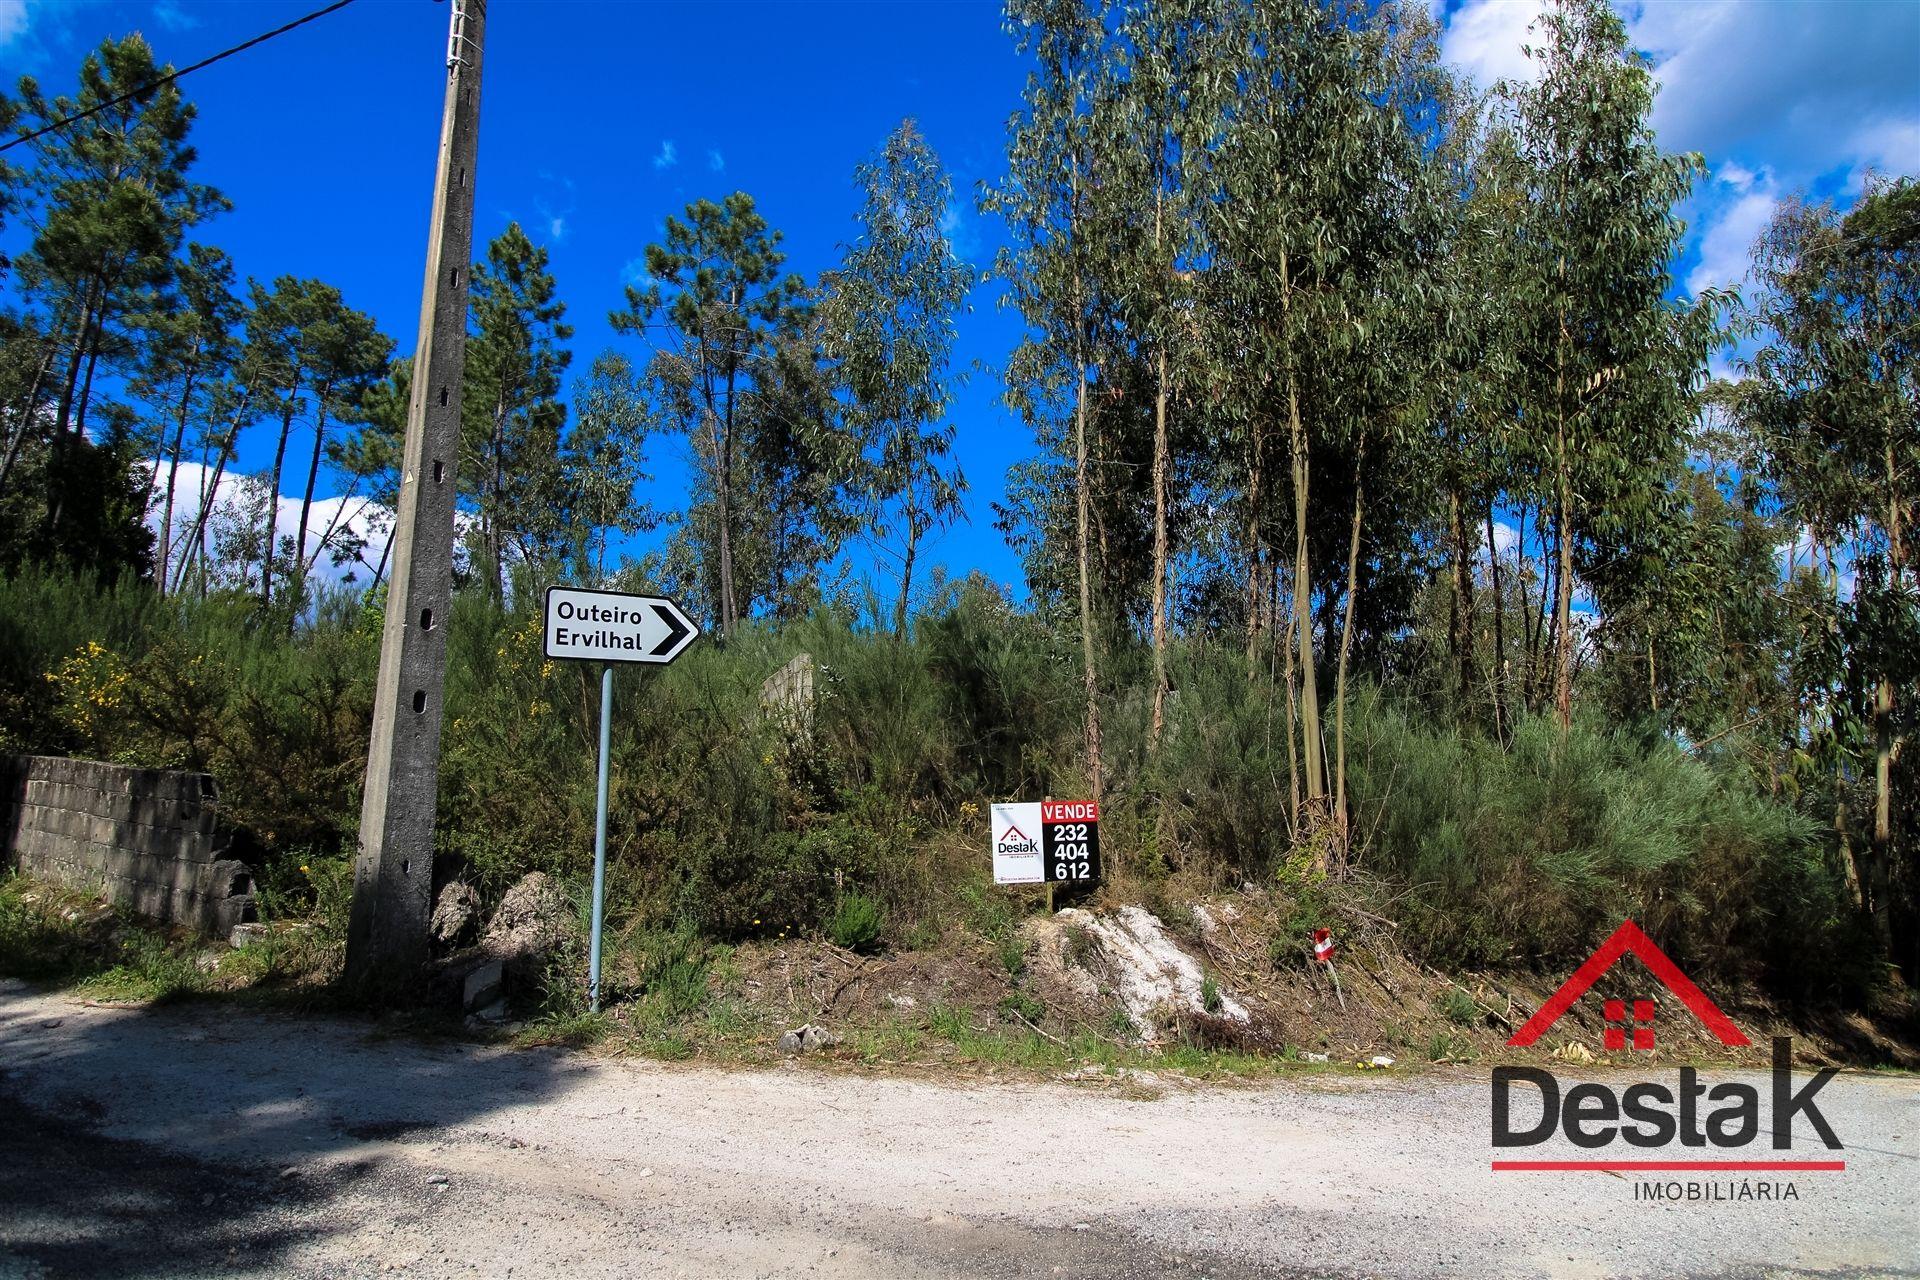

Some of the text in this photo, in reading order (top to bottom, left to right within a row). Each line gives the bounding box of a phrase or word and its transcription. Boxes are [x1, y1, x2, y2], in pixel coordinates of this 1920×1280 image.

[557, 601, 642, 625] Outeiro
[555, 627, 643, 650] Ervilhal
[1044, 803, 1095, 820] VENDE
[1053, 824, 1088, 842] 232
[998, 838, 1039, 853] Destak
[1055, 843, 1090, 860] 404
[1055, 862, 1090, 879] 612
